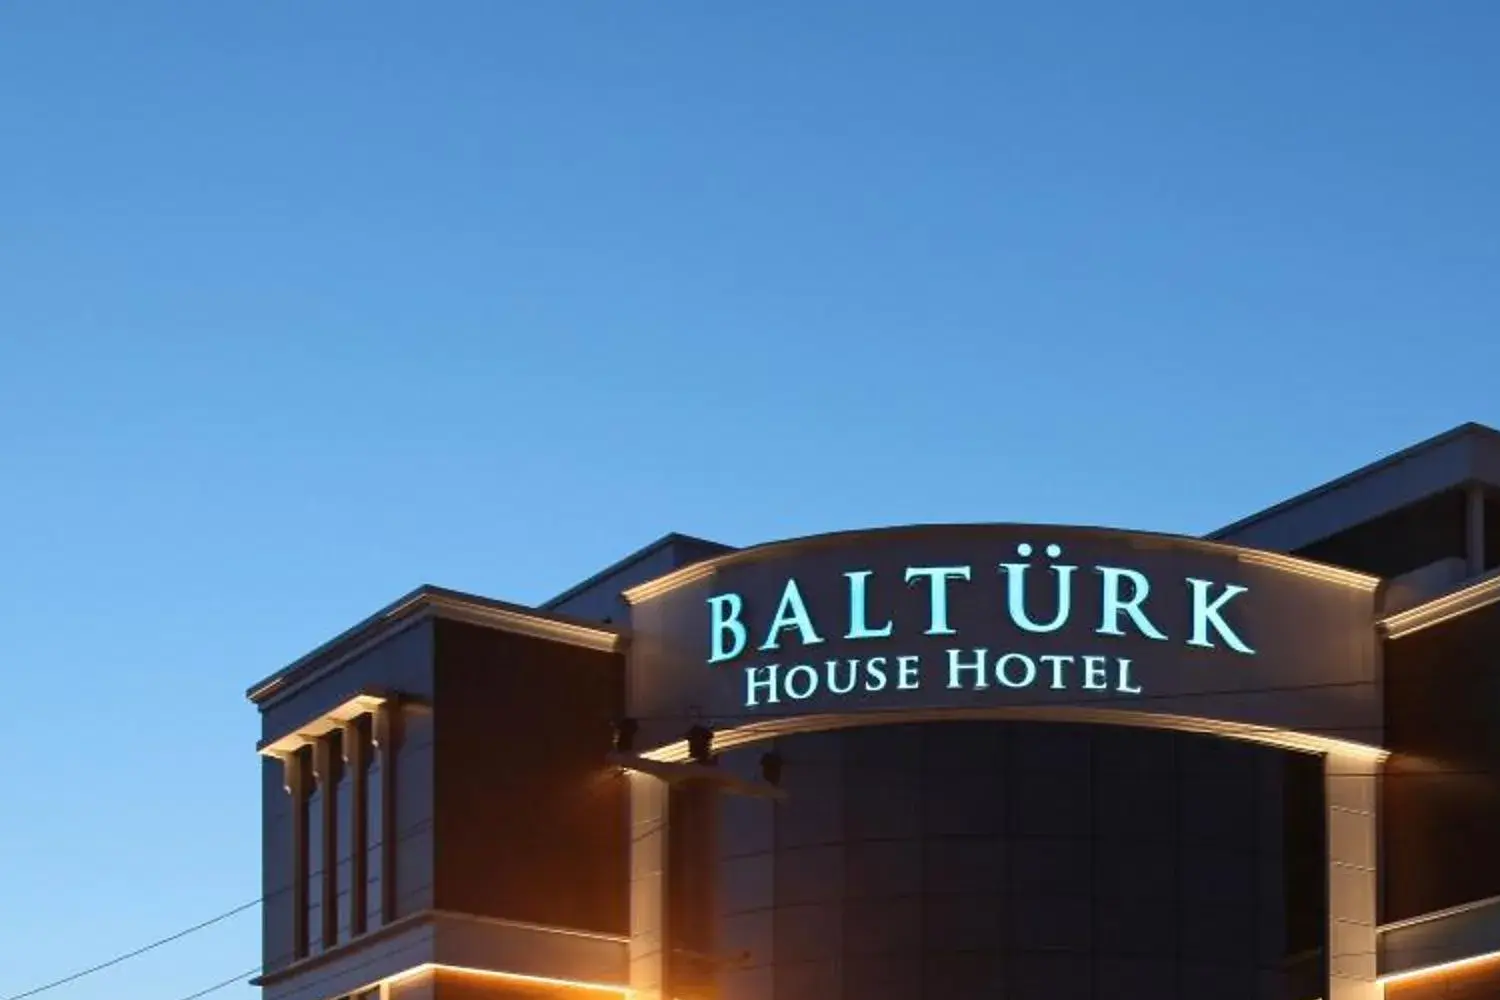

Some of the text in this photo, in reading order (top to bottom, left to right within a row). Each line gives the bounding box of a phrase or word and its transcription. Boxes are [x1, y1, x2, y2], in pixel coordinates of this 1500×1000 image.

[707, 543, 1255, 663] BALTÜRK
[745, 648, 1142, 707] HOUSE HOTEL
